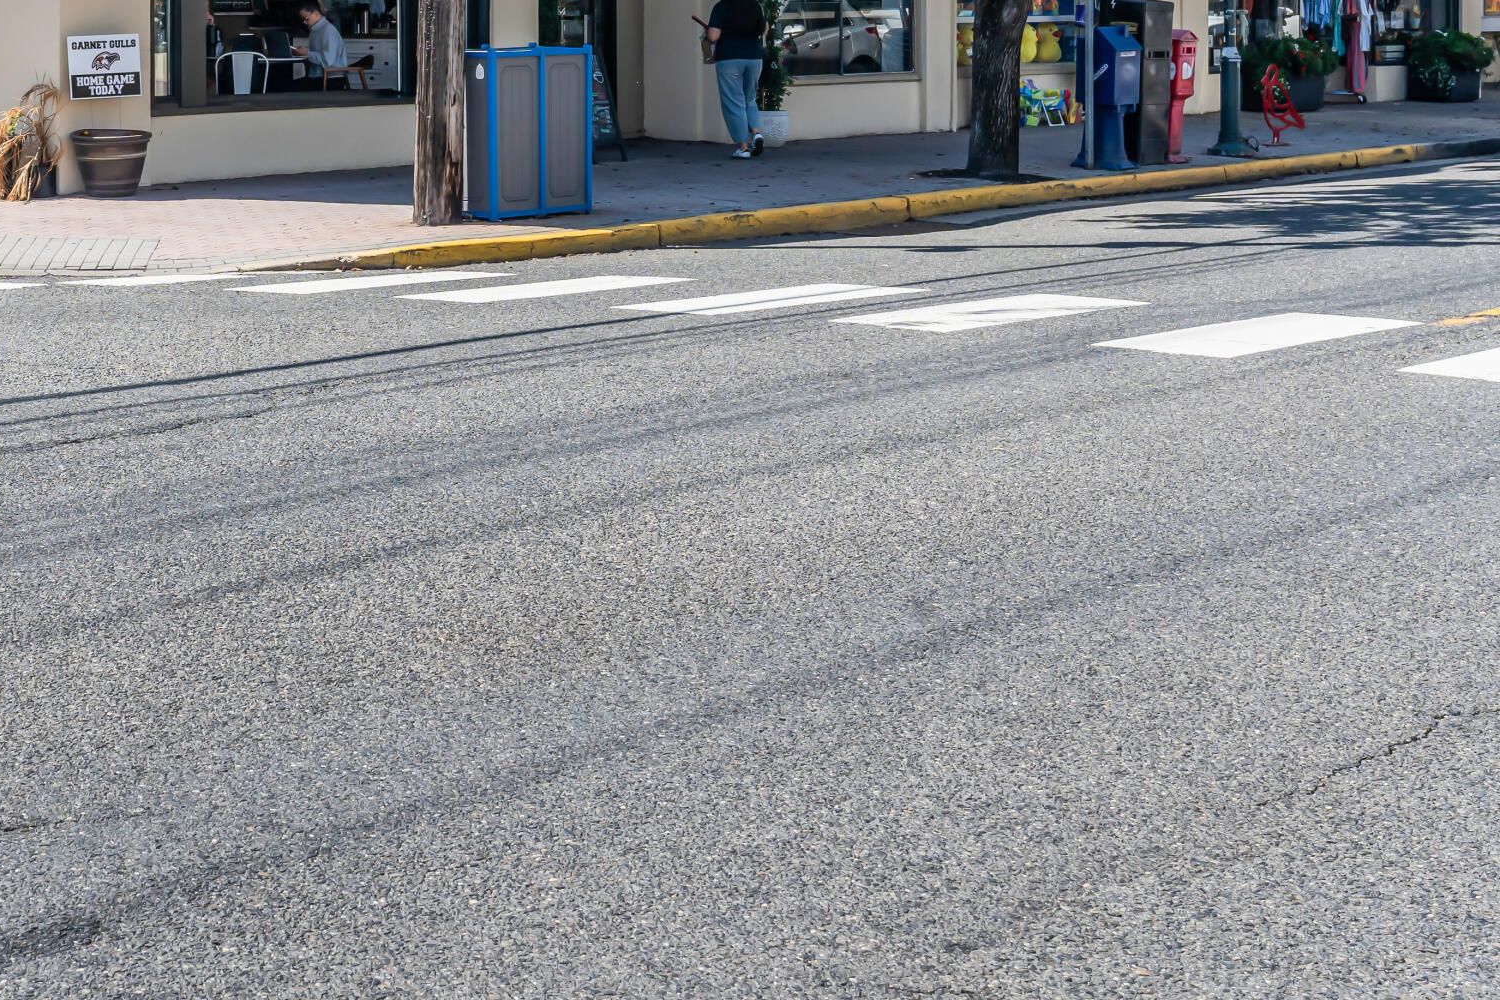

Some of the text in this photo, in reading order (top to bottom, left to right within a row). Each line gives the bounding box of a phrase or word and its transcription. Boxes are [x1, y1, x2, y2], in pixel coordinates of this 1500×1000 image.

[71, 39, 137, 50] GARNET GULLS
[76, 74, 135, 86] HOME GAME
[88, 84, 124, 96] TODAY
